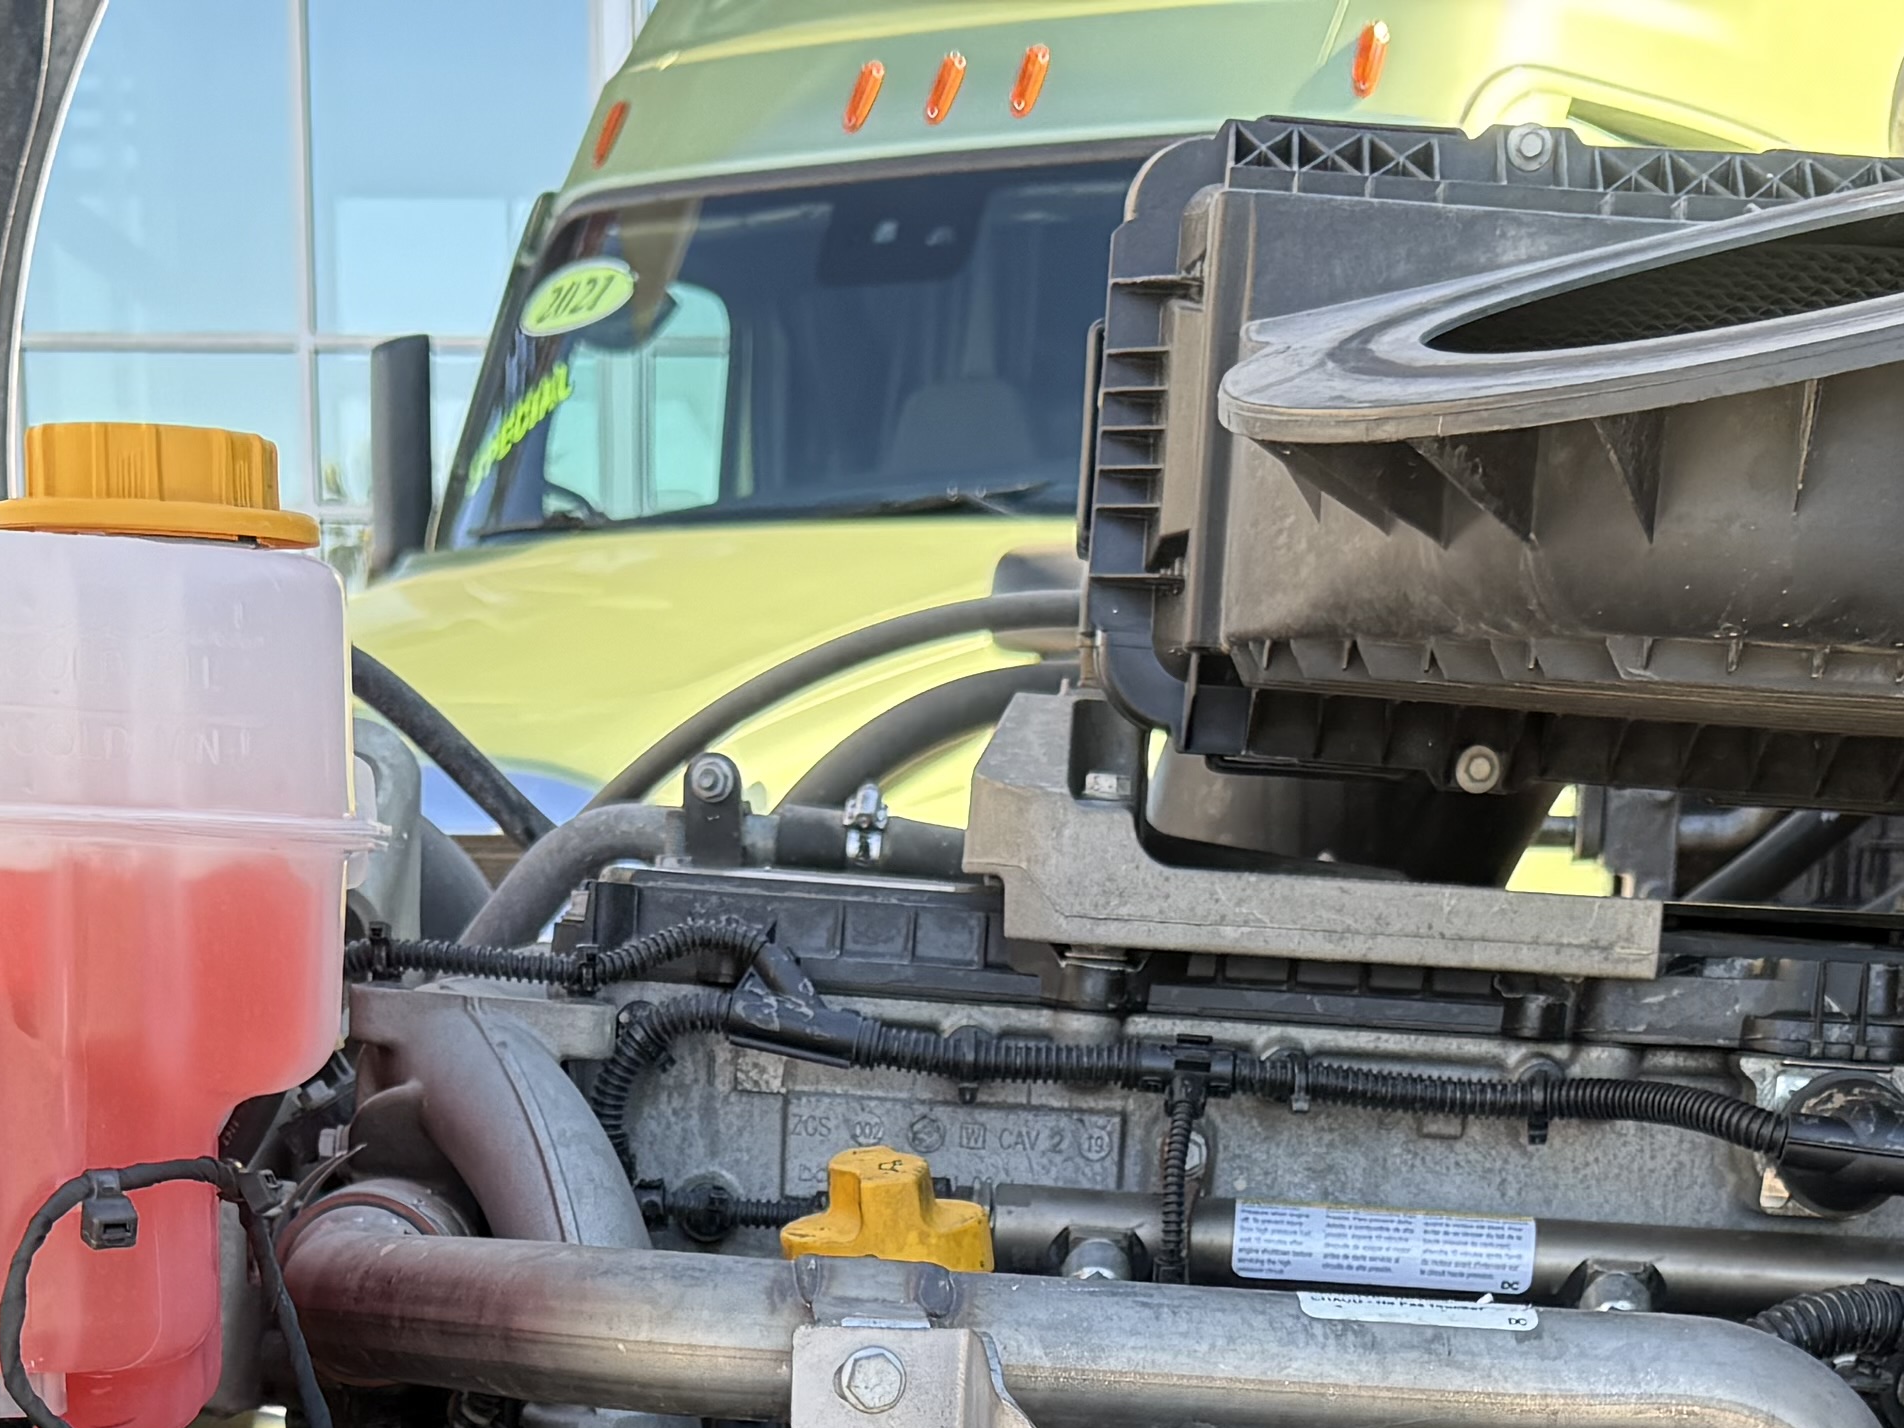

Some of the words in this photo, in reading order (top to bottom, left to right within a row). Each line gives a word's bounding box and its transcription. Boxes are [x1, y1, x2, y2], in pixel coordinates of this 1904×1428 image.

[999, 1127, 1039, 1153] CAV
[1049, 1131, 1065, 1154] 2
[1501, 1280, 1519, 1290] DC
[1508, 1316, 1527, 1326] DC
